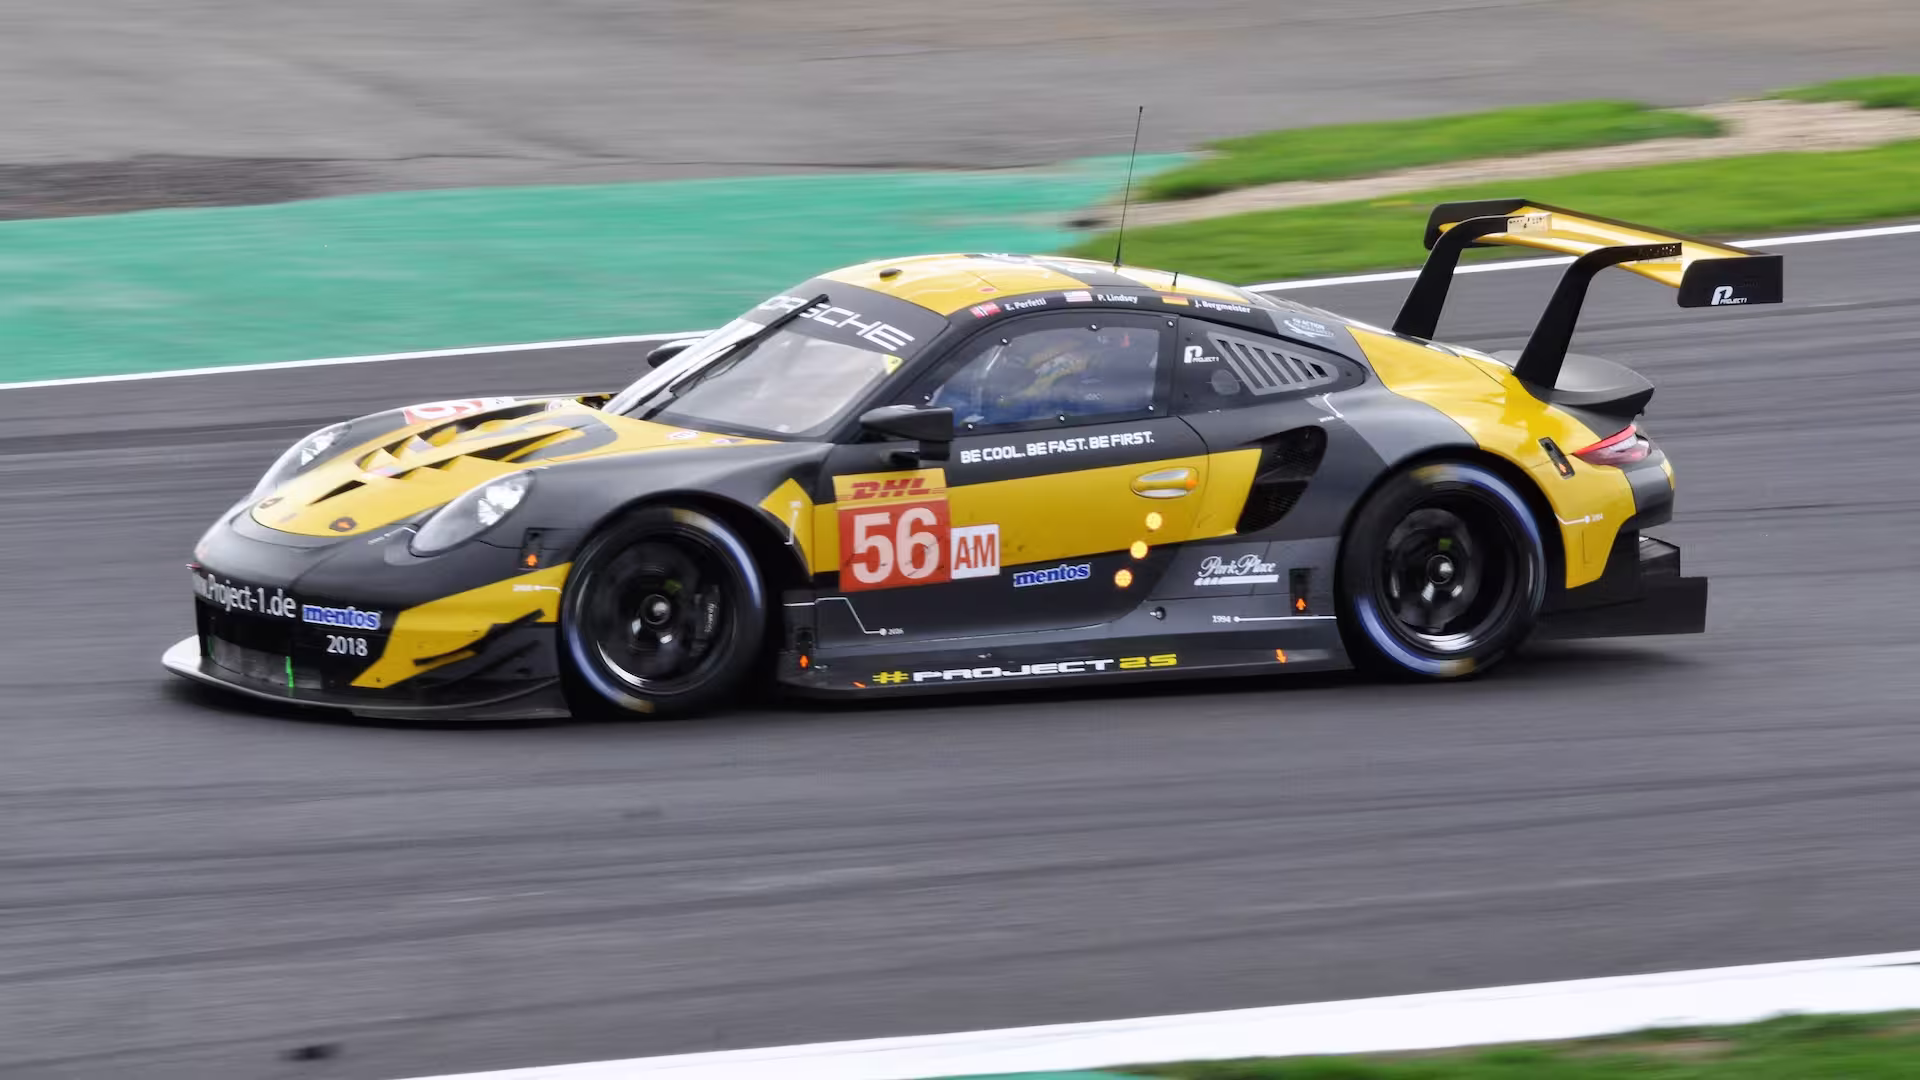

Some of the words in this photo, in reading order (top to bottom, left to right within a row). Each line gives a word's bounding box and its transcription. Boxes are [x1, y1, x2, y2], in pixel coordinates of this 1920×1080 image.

[1015, 297, 1047, 309] Perfetti
[1097, 294, 1105, 302] P.
[1106, 294, 1138, 304] Lindsey
[1194, 299, 1202, 309] J.
[1202, 300, 1251, 314] Bergmeister
[960, 449, 982, 463] BE
[982, 445, 1026, 461] COOL.
[1026, 441, 1048, 456] BE
[1048, 437, 1088, 454] FAST.
[1089, 435, 1110, 449] BE
[1110, 431, 1155, 447] FIRST.
[851, 477, 929, 500] DHL
[852, 507, 941, 584] 56
[954, 533, 996, 571] AM
[1013, 563, 1091, 587] mentos
[1197, 555, 1237, 577] Park
[1235, 553, 1276, 576] Place
[193, 573, 297, 618] .Project-1.de
[302, 604, 381, 630] mentos
[326, 635, 368, 656] 2018
